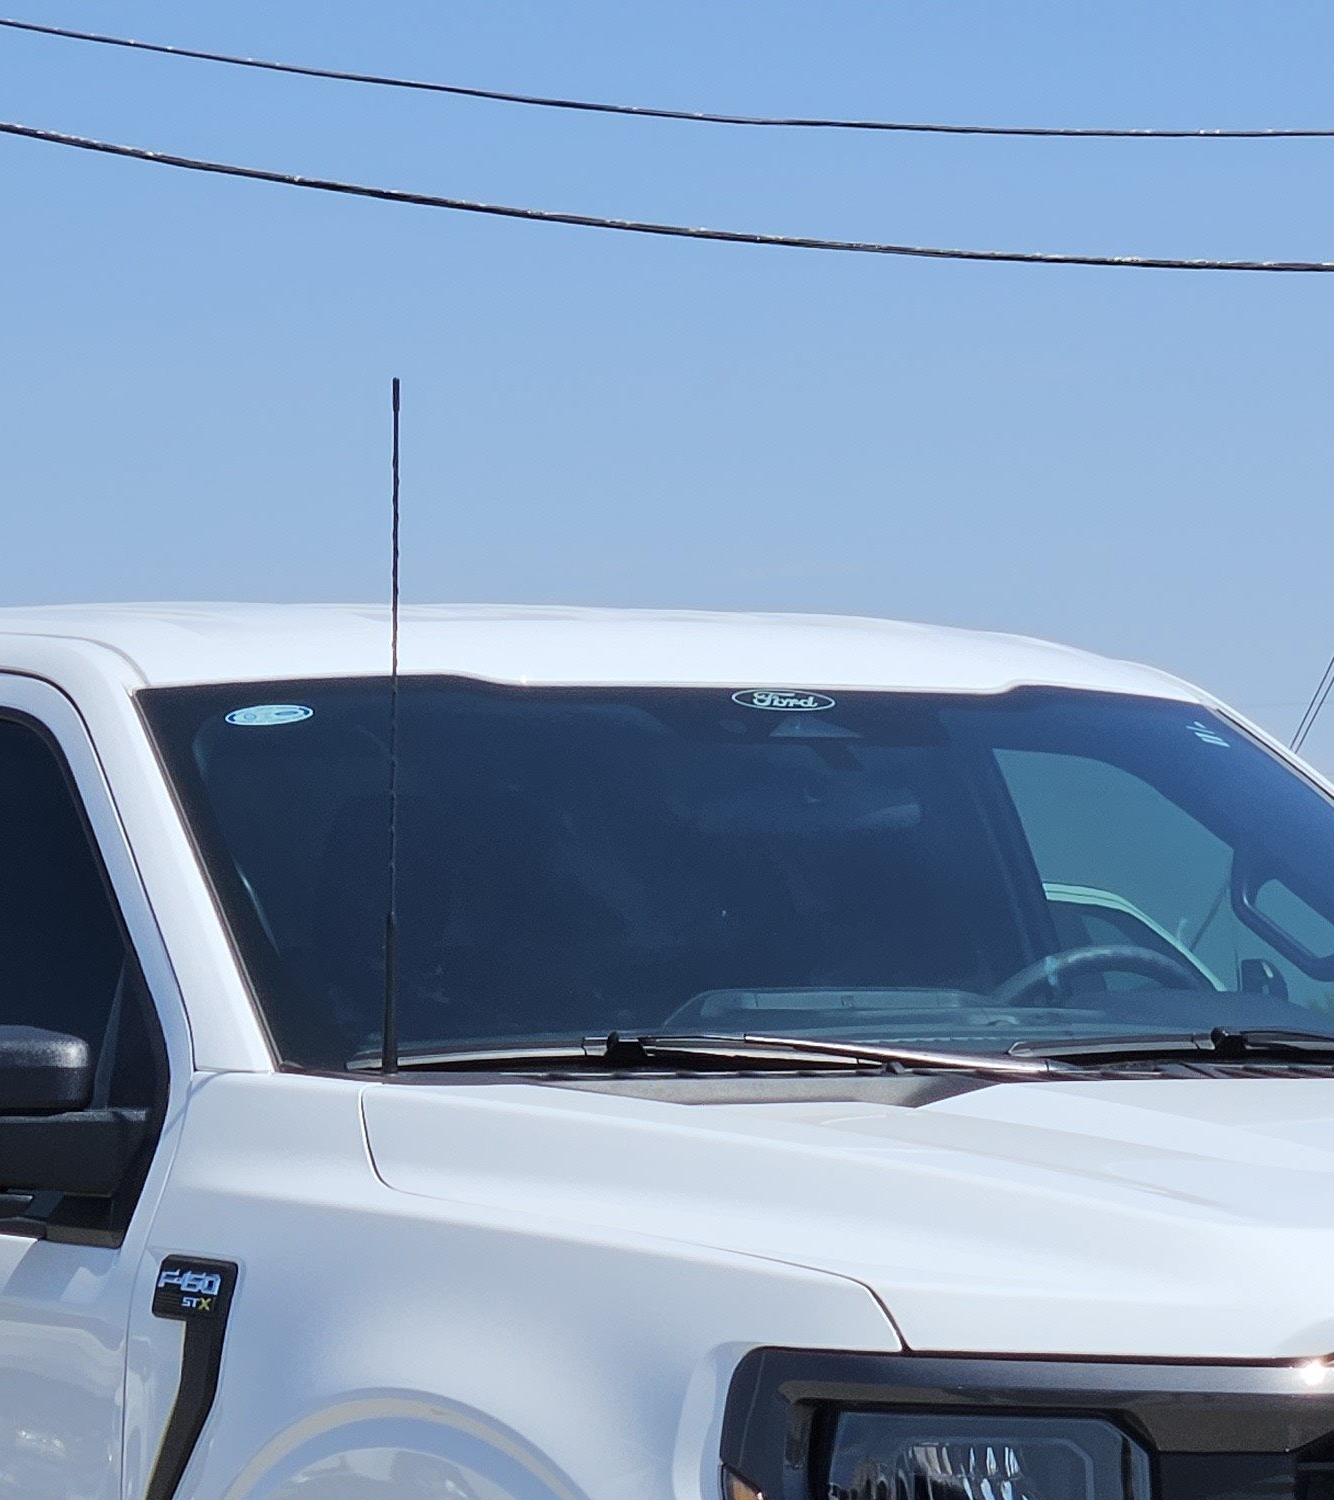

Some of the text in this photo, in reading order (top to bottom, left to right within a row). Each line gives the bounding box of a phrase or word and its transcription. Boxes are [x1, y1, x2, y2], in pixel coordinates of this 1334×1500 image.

[752, 690, 818, 708] Ford
[157, 1268, 222, 1296] F-150
[181, 1296, 212, 1311] STX
